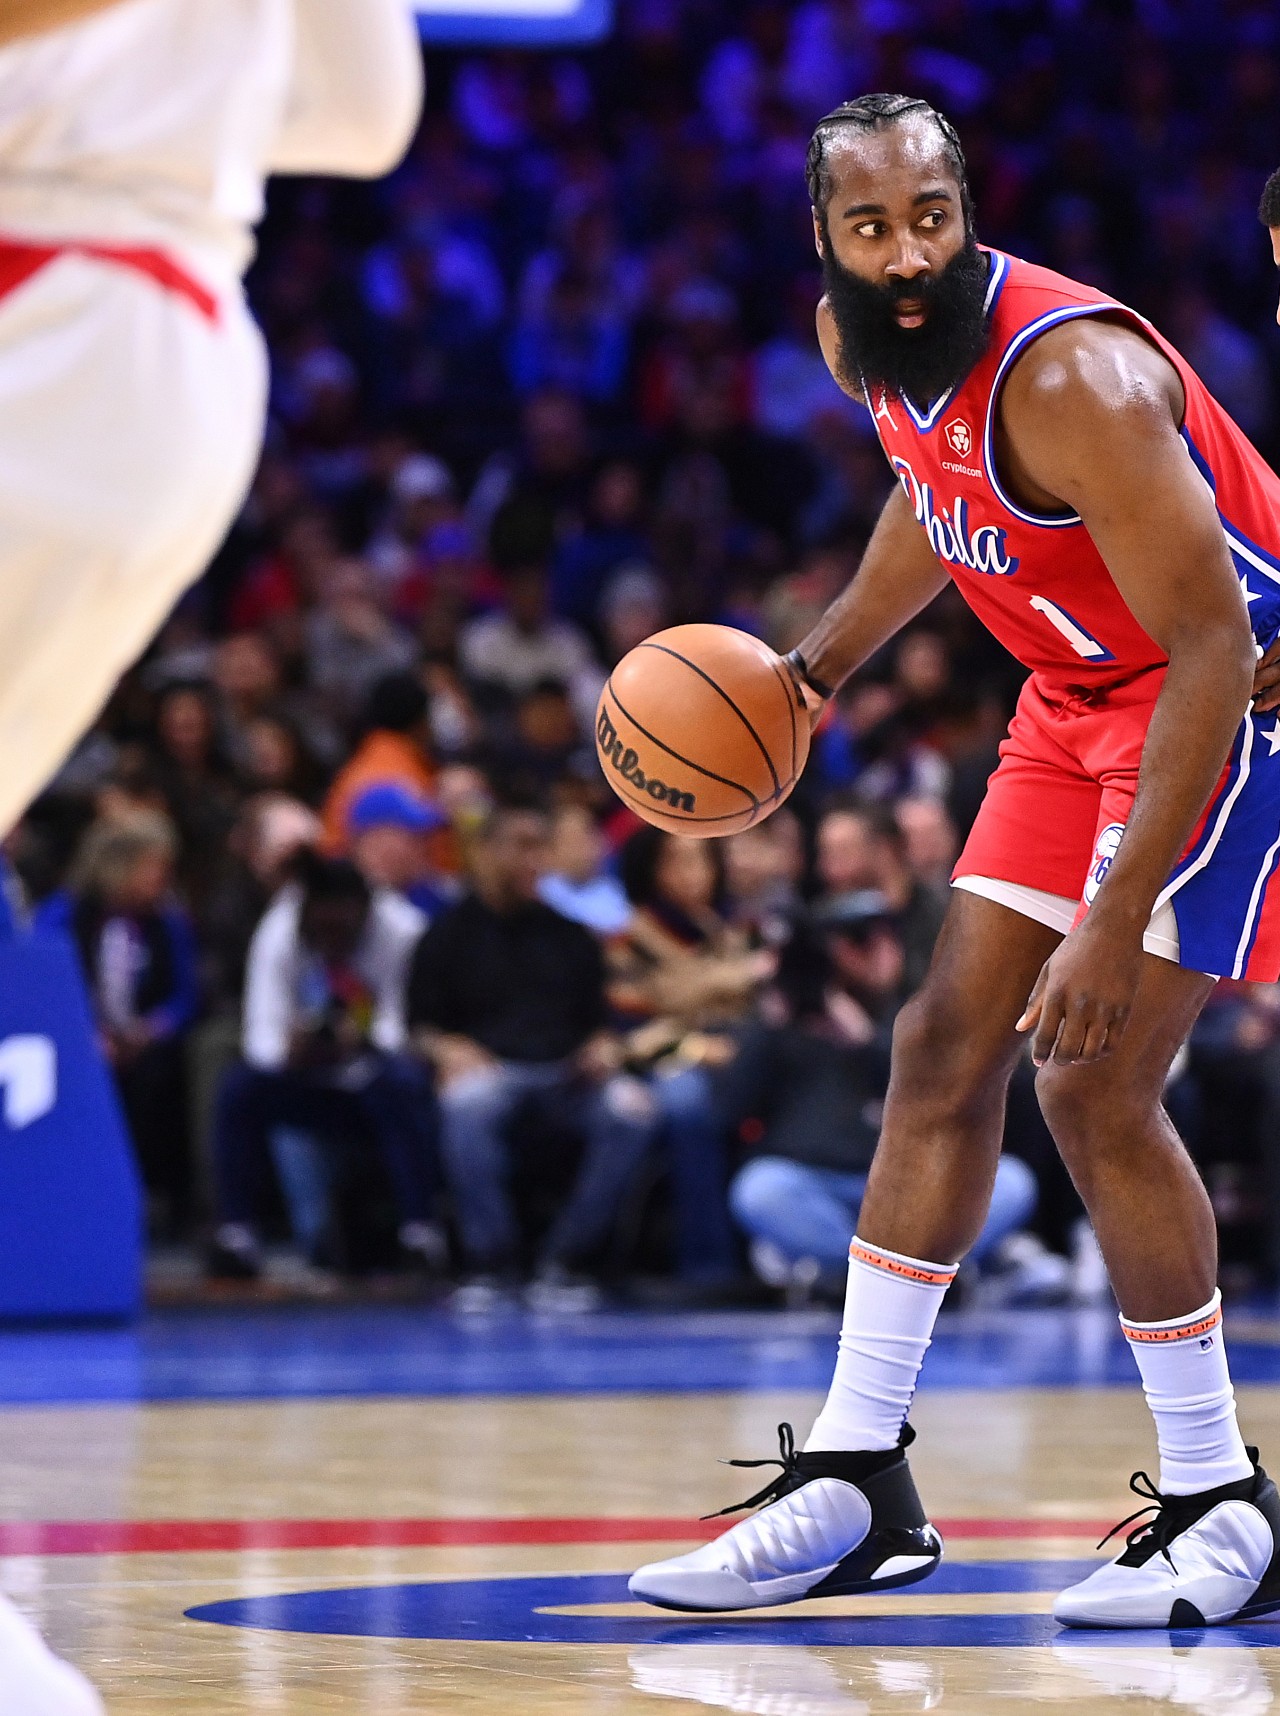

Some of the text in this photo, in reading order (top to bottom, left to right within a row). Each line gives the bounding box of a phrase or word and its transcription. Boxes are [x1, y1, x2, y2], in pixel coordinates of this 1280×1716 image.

[941, 461, 983, 478] crypto.com
[1028, 595, 1117, 663] 1
[598, 704, 696, 813] Wilson
